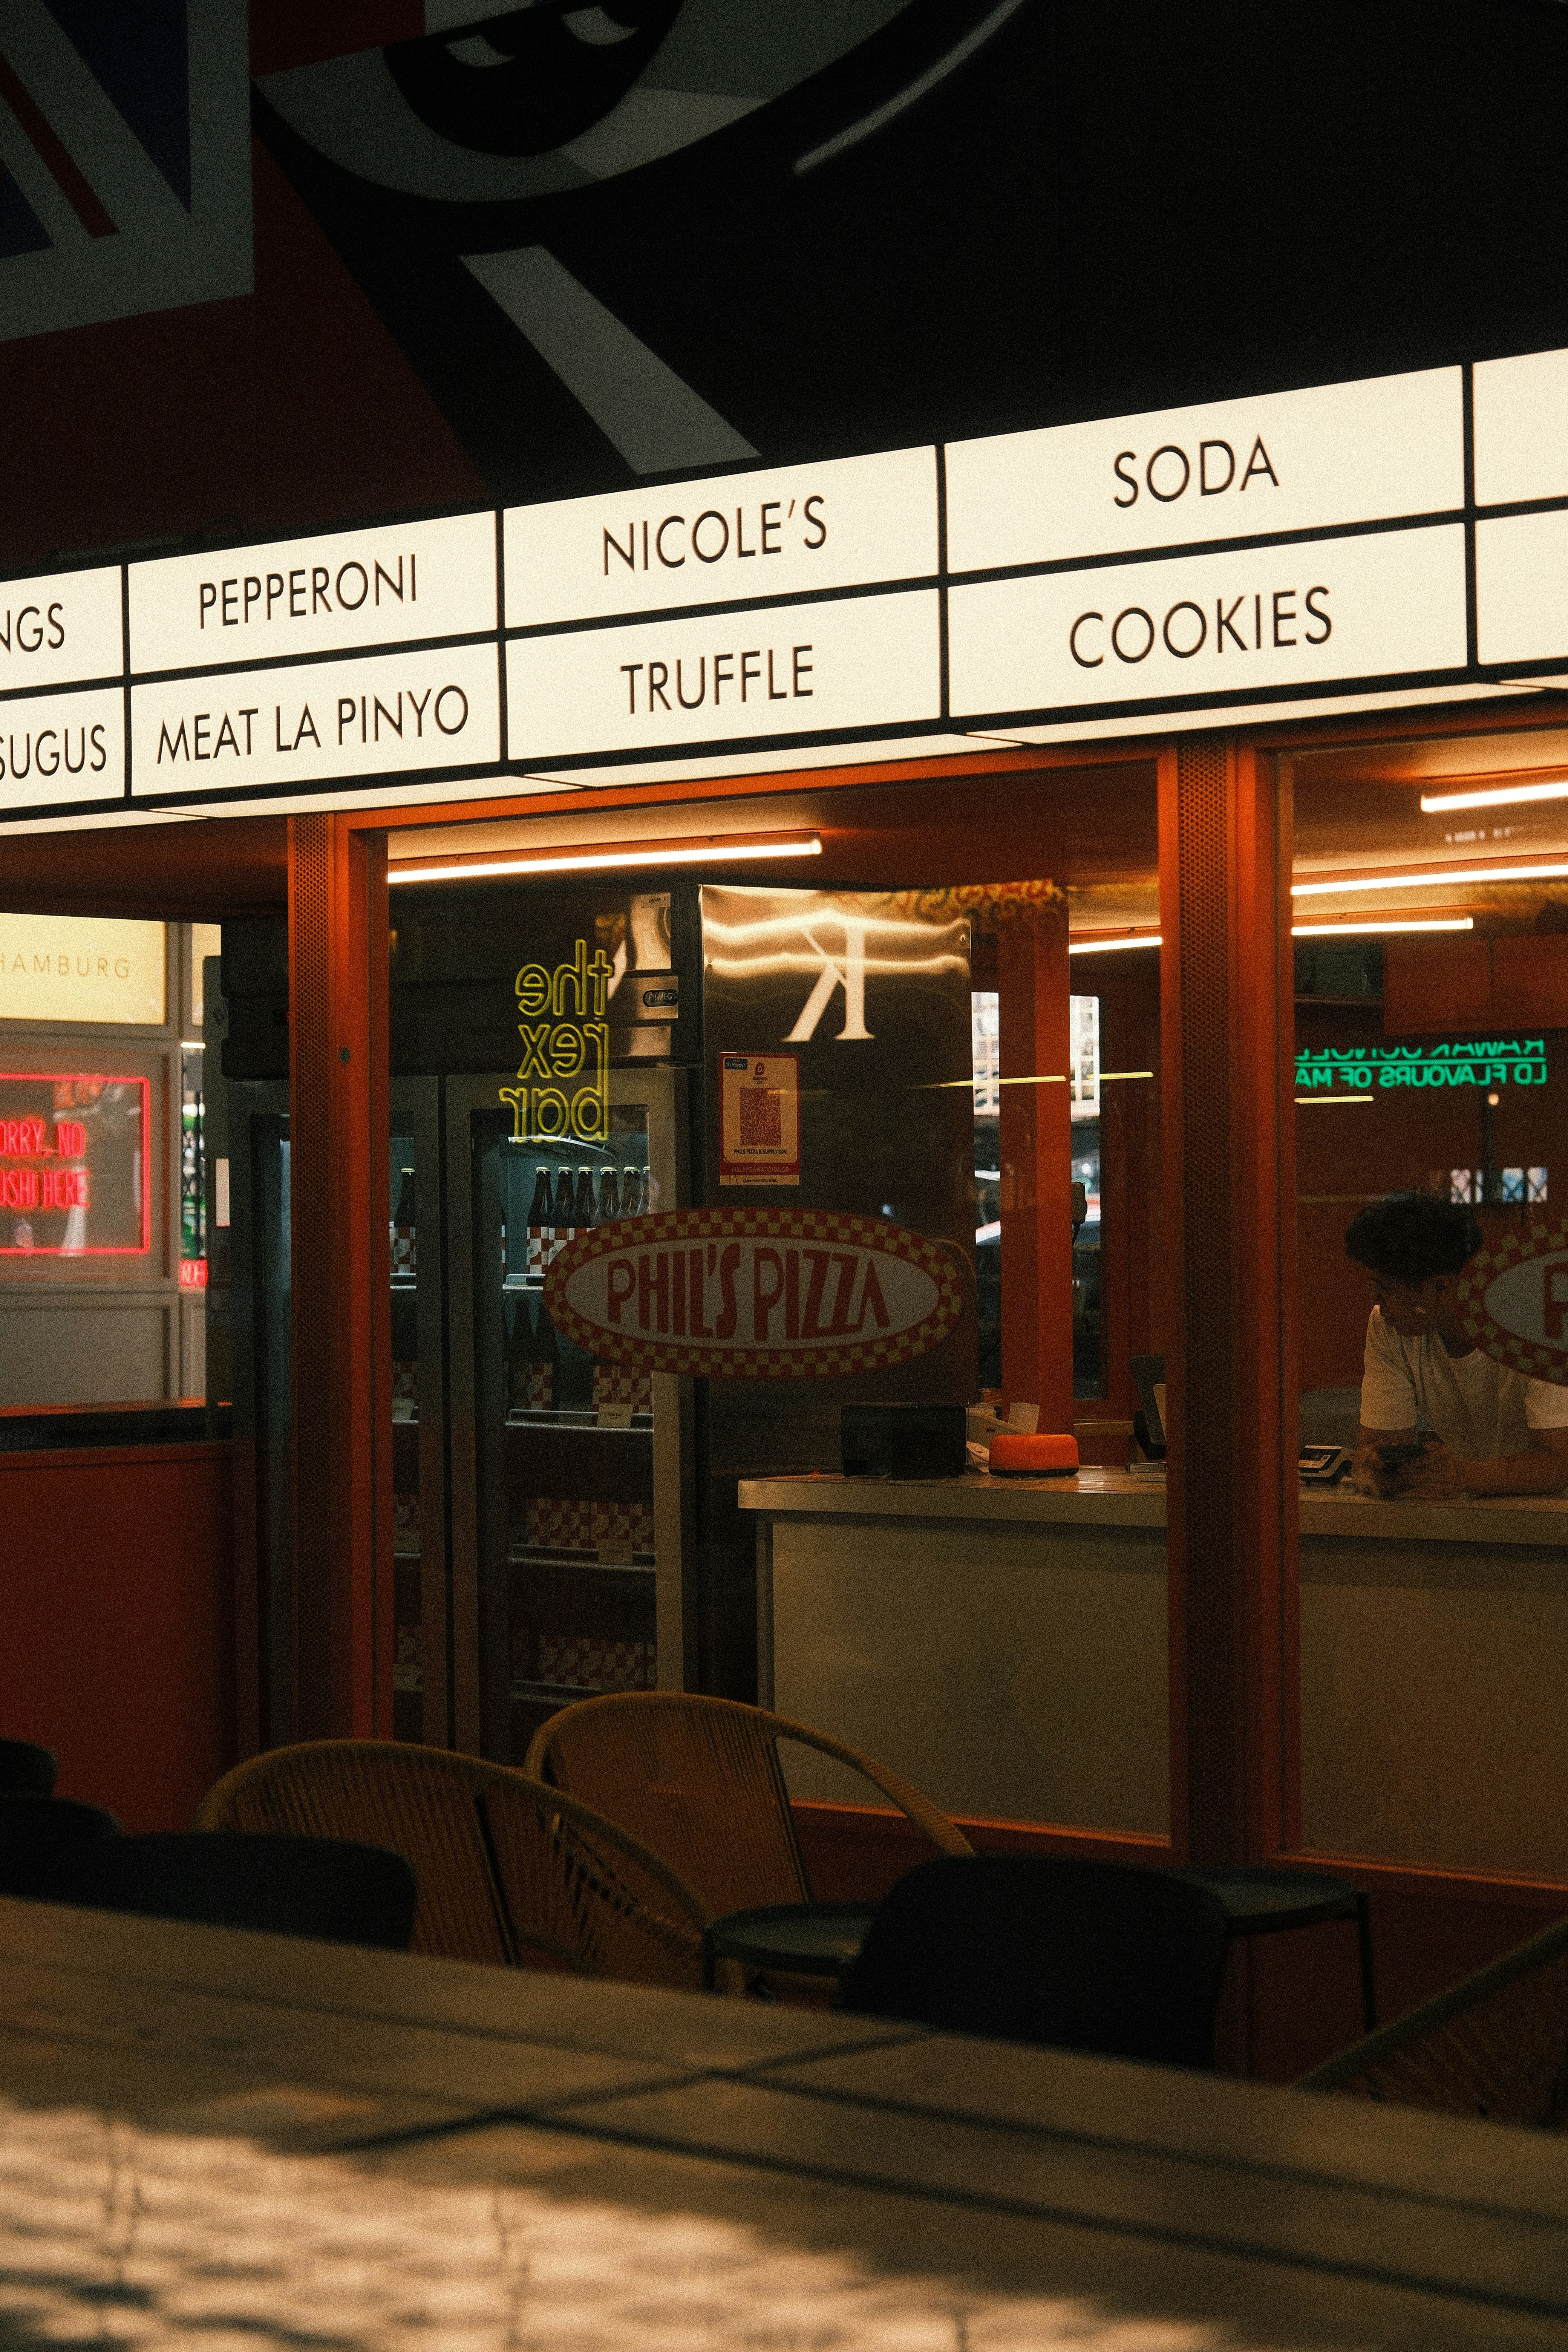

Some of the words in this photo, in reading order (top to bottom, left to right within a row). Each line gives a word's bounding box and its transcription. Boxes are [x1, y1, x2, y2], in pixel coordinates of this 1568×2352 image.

[1114, 434, 1279, 508] SODA
[603, 495, 827, 576] NICOLE'S
[200, 554, 416, 629] PEPPERONI
[1070, 586, 1332, 668] COOKIES
[620, 645, 813, 714] TRUFFLE
[157, 708, 259, 764] MEAT
[276, 702, 321, 752] LA
[338, 685, 469, 745] PINYO
[57, 1122, 86, 1157] NO
[43, 1170, 90, 1208] HERE
[607, 1242, 741, 1341] PHIL'S
[753, 1247, 891, 1342] PIZZA
